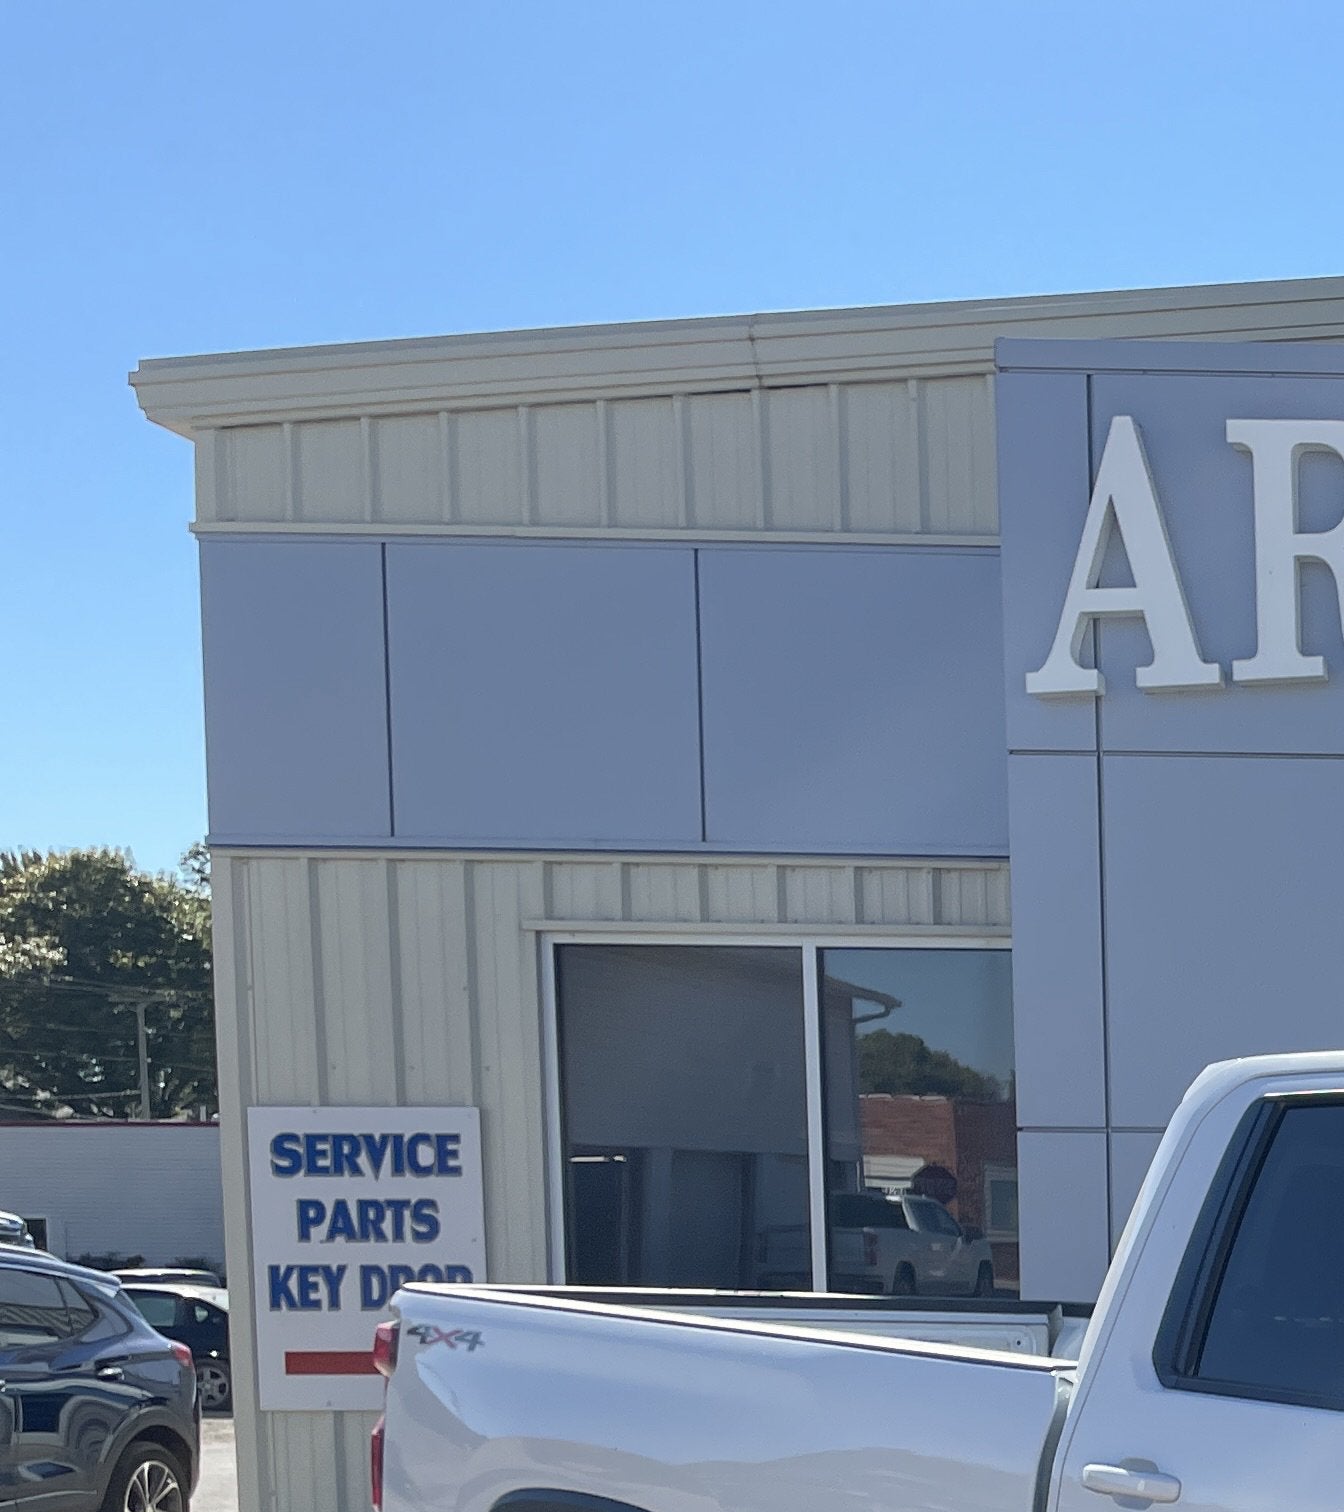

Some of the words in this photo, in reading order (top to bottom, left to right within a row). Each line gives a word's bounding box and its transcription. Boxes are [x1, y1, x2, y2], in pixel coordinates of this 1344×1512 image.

[270, 1132, 463, 1182] SERVICE
[296, 1198, 442, 1244] PARTS
[267, 1264, 347, 1312] KEY
